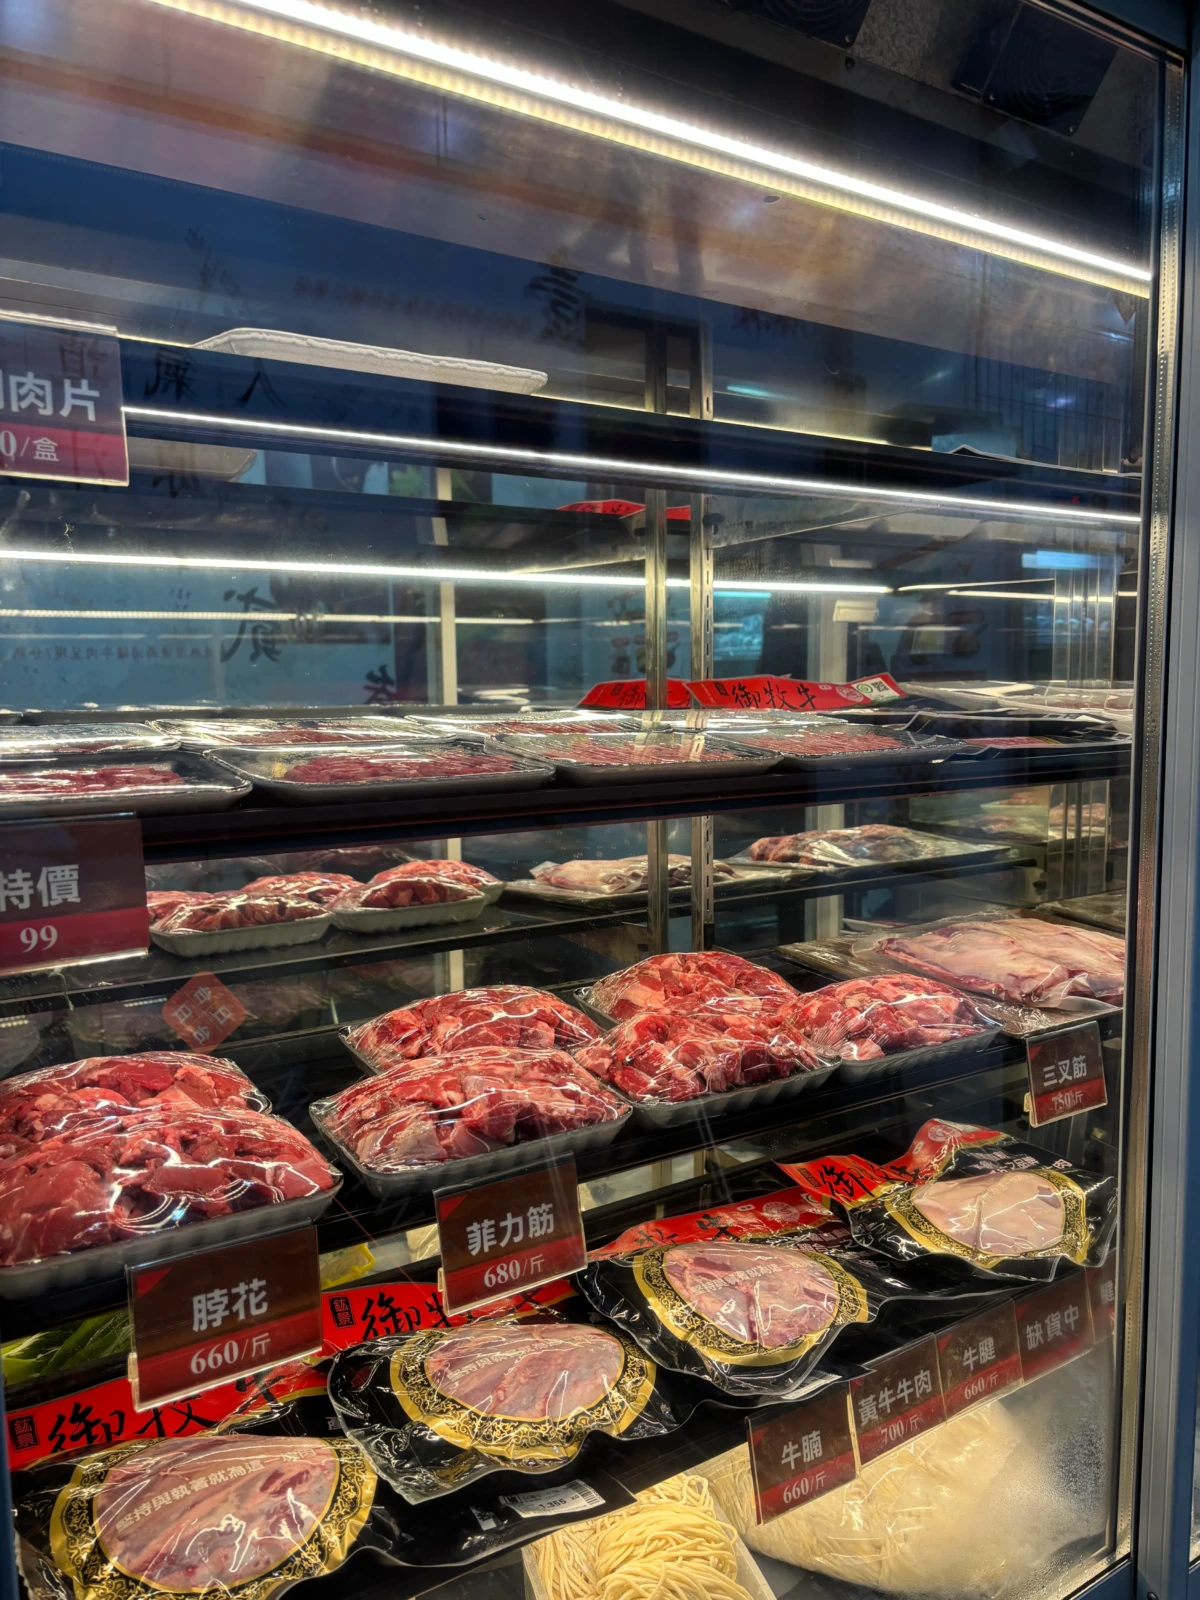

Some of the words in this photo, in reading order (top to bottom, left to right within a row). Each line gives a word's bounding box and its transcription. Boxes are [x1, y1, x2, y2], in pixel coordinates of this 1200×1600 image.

[0, 370, 99, 421] 肉片
[731, 681, 816, 711] 御牧牛
[0, 864, 81, 912] 特價
[20, 925, 58, 953] 99
[1043, 1055, 1088, 1087] 三叉筋
[466, 1203, 554, 1256] 菲力筋
[483, 1254, 545, 1287] 680/斤
[192, 1278, 268, 1332] 脖花
[1026, 1304, 1079, 1350] 缺貨中
[190, 1333, 271, 1374] 660/斤
[962, 1336, 996, 1371] 牛腱
[859, 1369, 932, 1426] 黃牛牛肉
[964, 1371, 998, 1400] 660/斤
[880, 1414, 920, 1446] 700/斤
[781, 1430, 822, 1470] 牛腩
[783, 1471, 827, 1504] 660/斤
